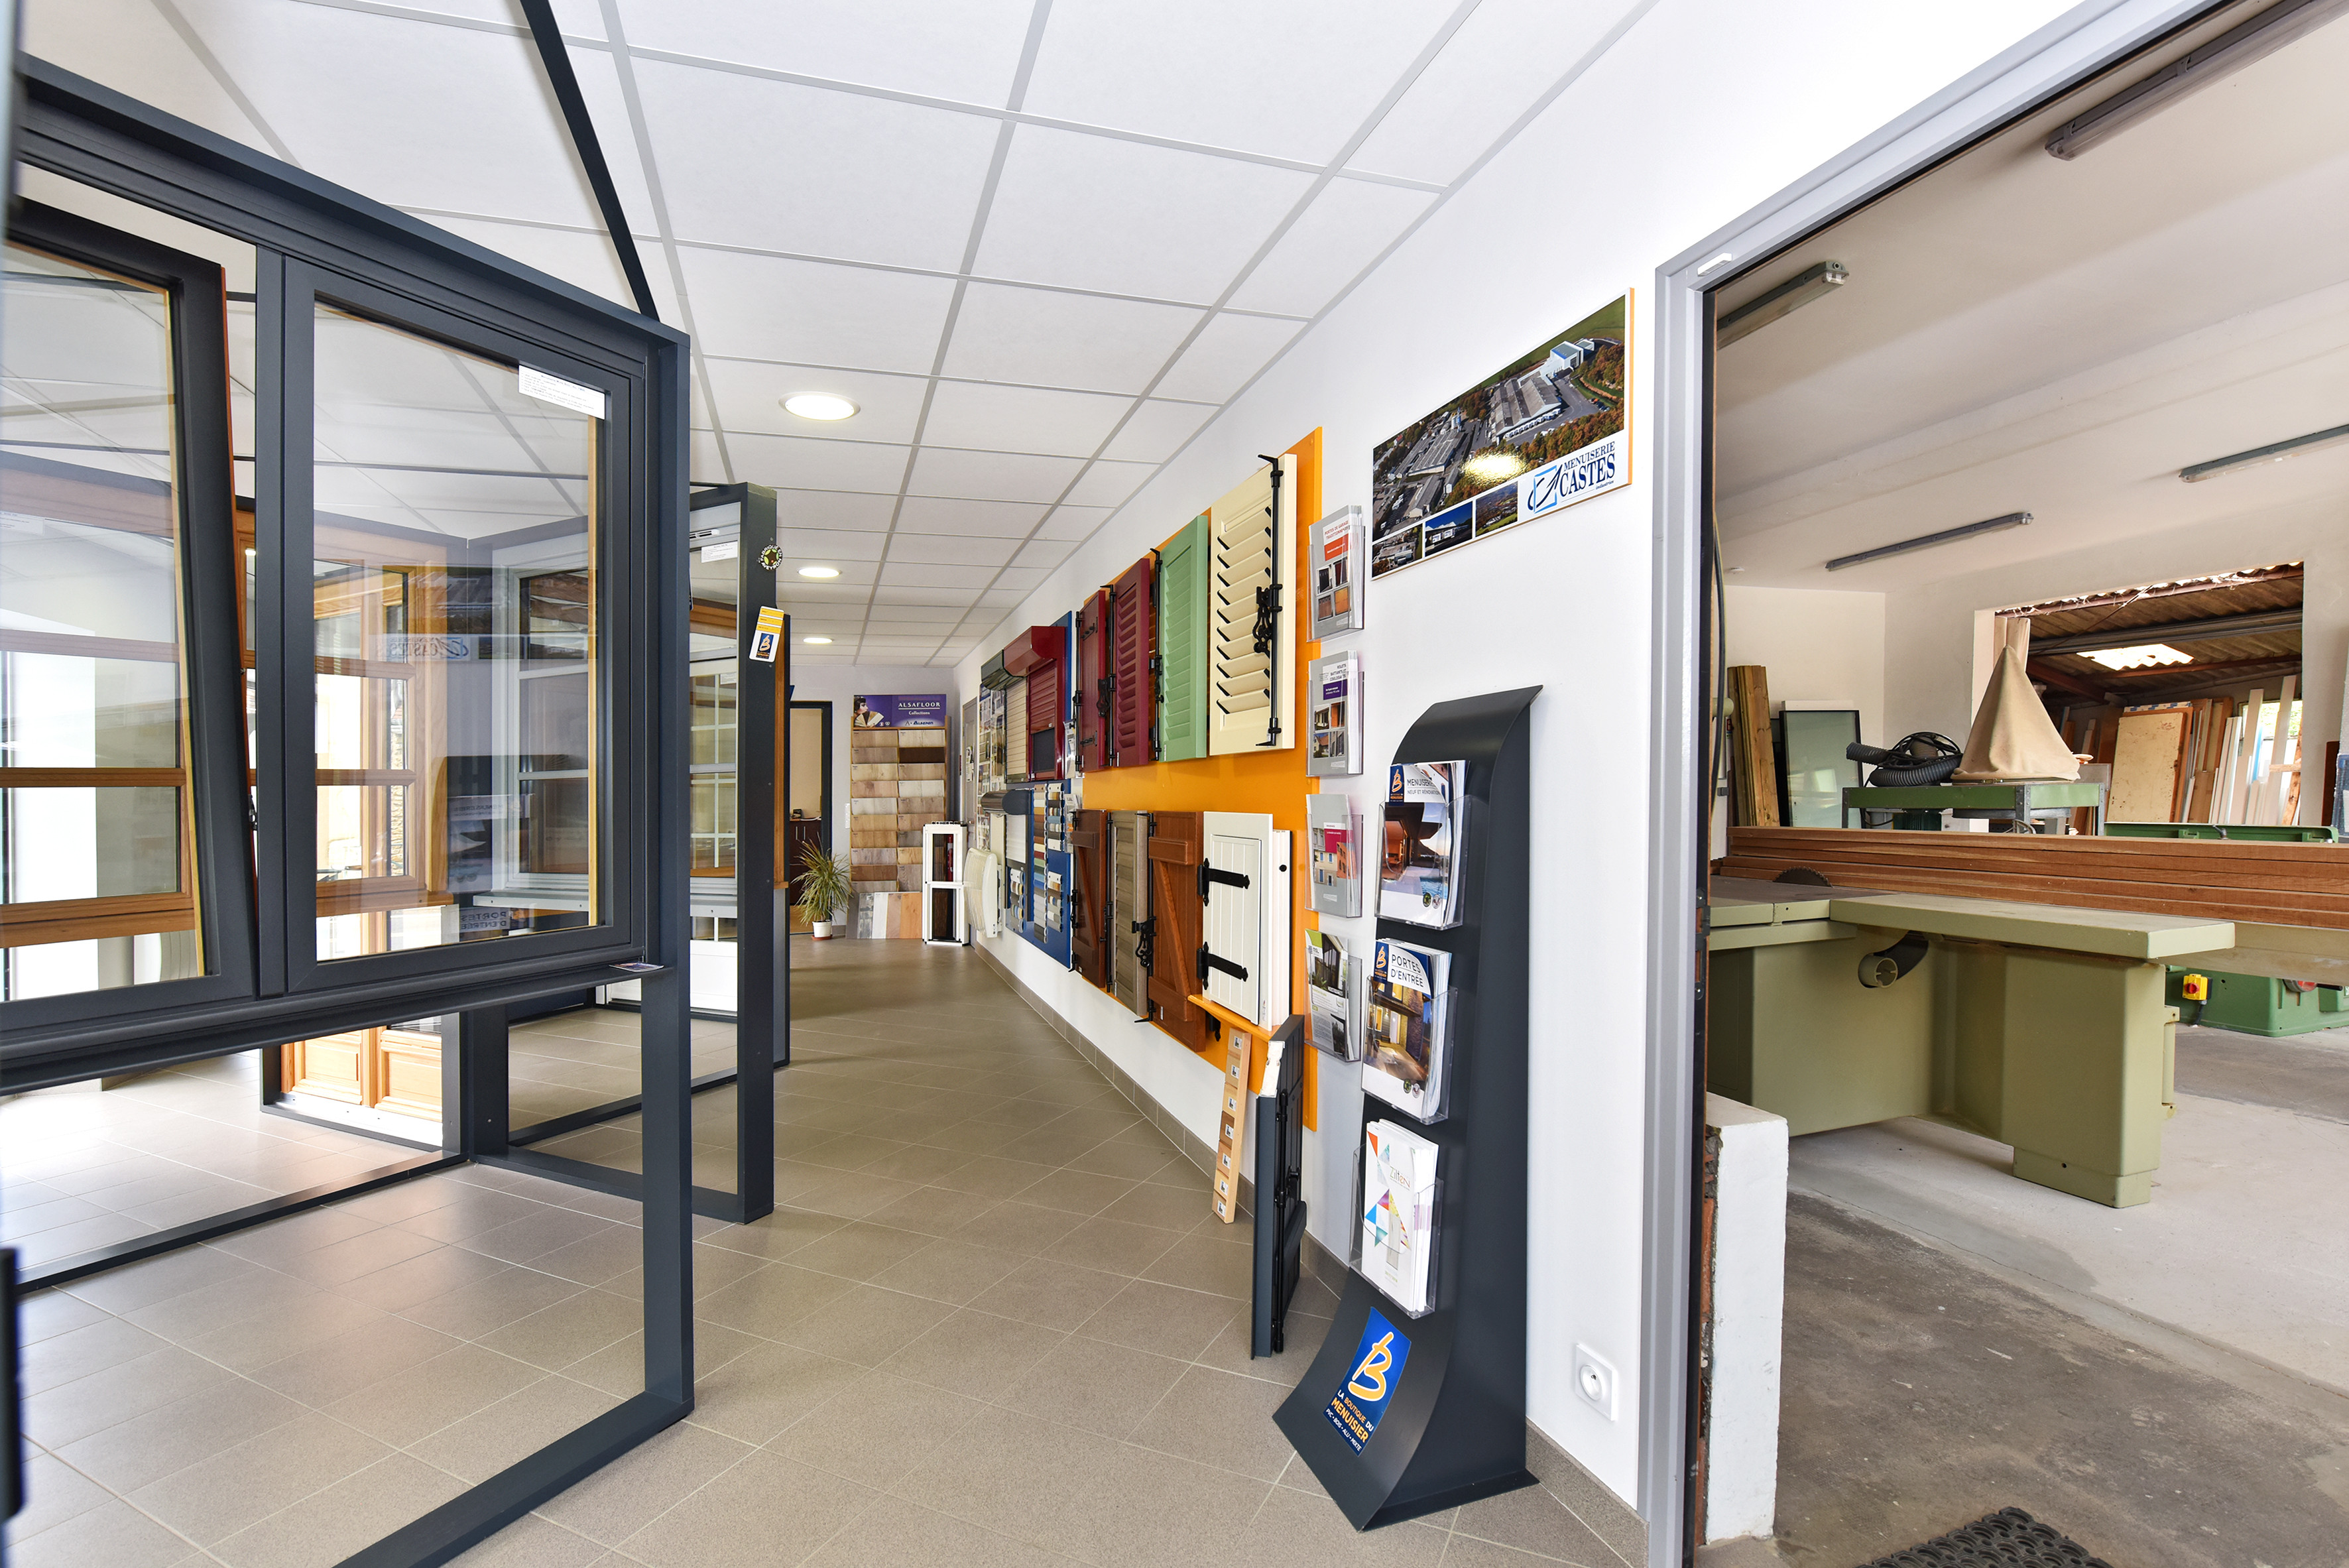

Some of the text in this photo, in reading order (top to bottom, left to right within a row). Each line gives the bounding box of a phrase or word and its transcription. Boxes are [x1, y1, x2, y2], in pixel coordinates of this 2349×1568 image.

[1564, 441, 1616, 471] MENUISERIE
[1559, 453, 1616, 497] CASTES
[760, 558, 782, 570] AVEYRON
[1391, 969, 1423, 987] D'ENTRÉE
[1392, 954, 1421, 973] PORTES
[1348, 1331, 1394, 1402] B
[1331, 1397, 1368, 1443] MENUISIER
[1337, 1390, 1374, 1431] LA BOUTIQUE DU
[1333, 1417, 1343, 1428] BOIS
[1342, 1429, 1351, 1438] ALU
[1351, 1437, 1362, 1451] MIXTE
